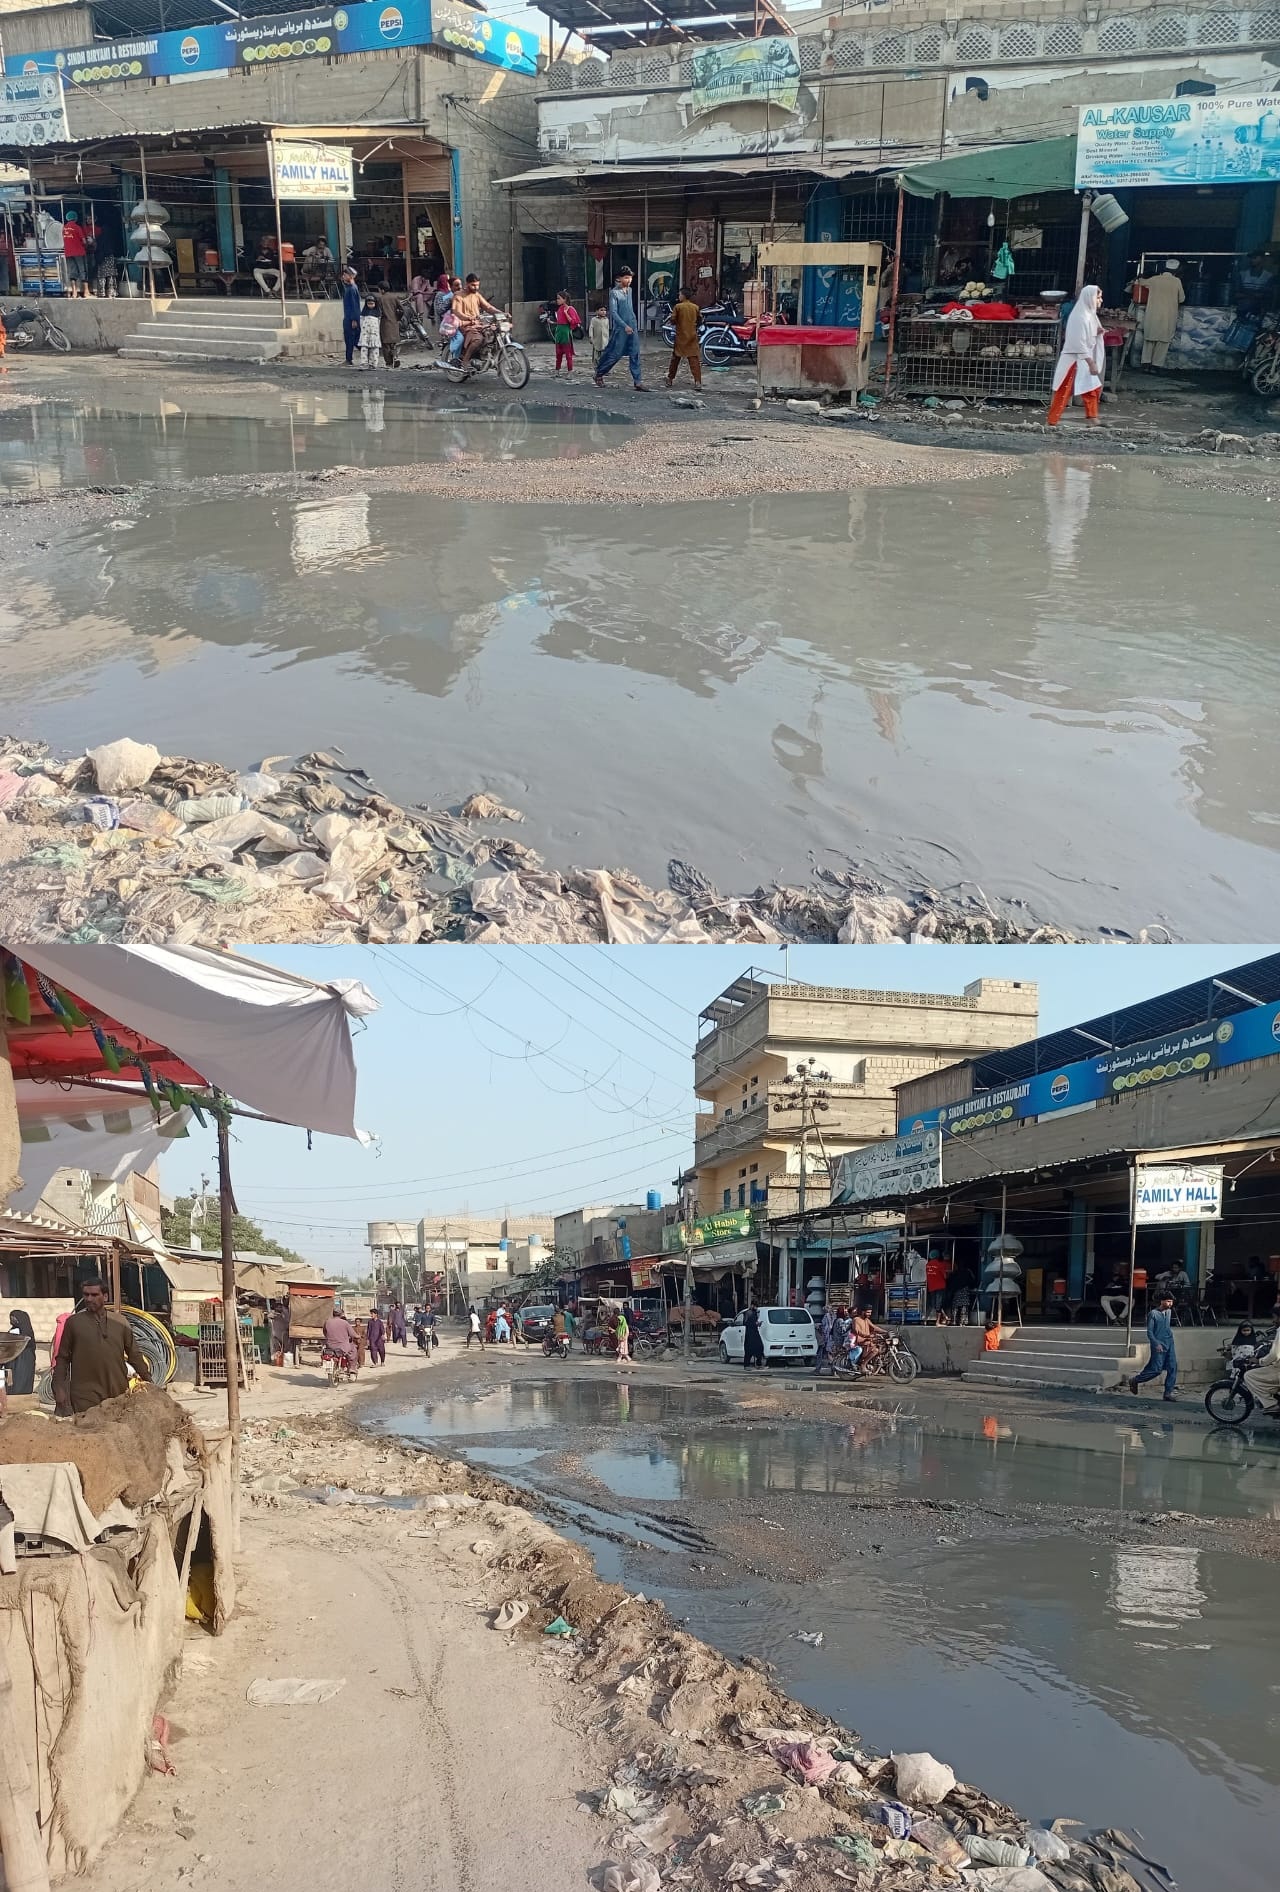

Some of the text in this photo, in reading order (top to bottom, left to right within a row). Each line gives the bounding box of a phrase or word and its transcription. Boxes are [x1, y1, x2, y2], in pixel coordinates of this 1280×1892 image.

[277, 21, 304, 36] بریانی
[305, 17, 333, 31] سندھ
[380, 20, 402, 28] PEPSI
[67, 39, 158, 66] SINDH BIRYANI & RESTAURANT
[1197, 100, 1224, 111] 100%
[1227, 100, 1253, 109] Pure
[1083, 104, 1191, 126] AL-KAUSAR
[1096, 126, 1175, 140] Water Supply
[276, 164, 349, 180] FAMILY HALL
[1181, 1030, 1214, 1050] سندھ
[1150, 1042, 1180, 1061] بریانی
[1051, 1084, 1069, 1094] PEPSI
[948, 1083, 1030, 1120] SINDH BIRYANI & RESTAURANT
[1136, 1186, 1218, 1204] FAMILY HALL
[704, 1217, 738, 1232] Al Habib
[711, 1228, 731, 1238] Store
